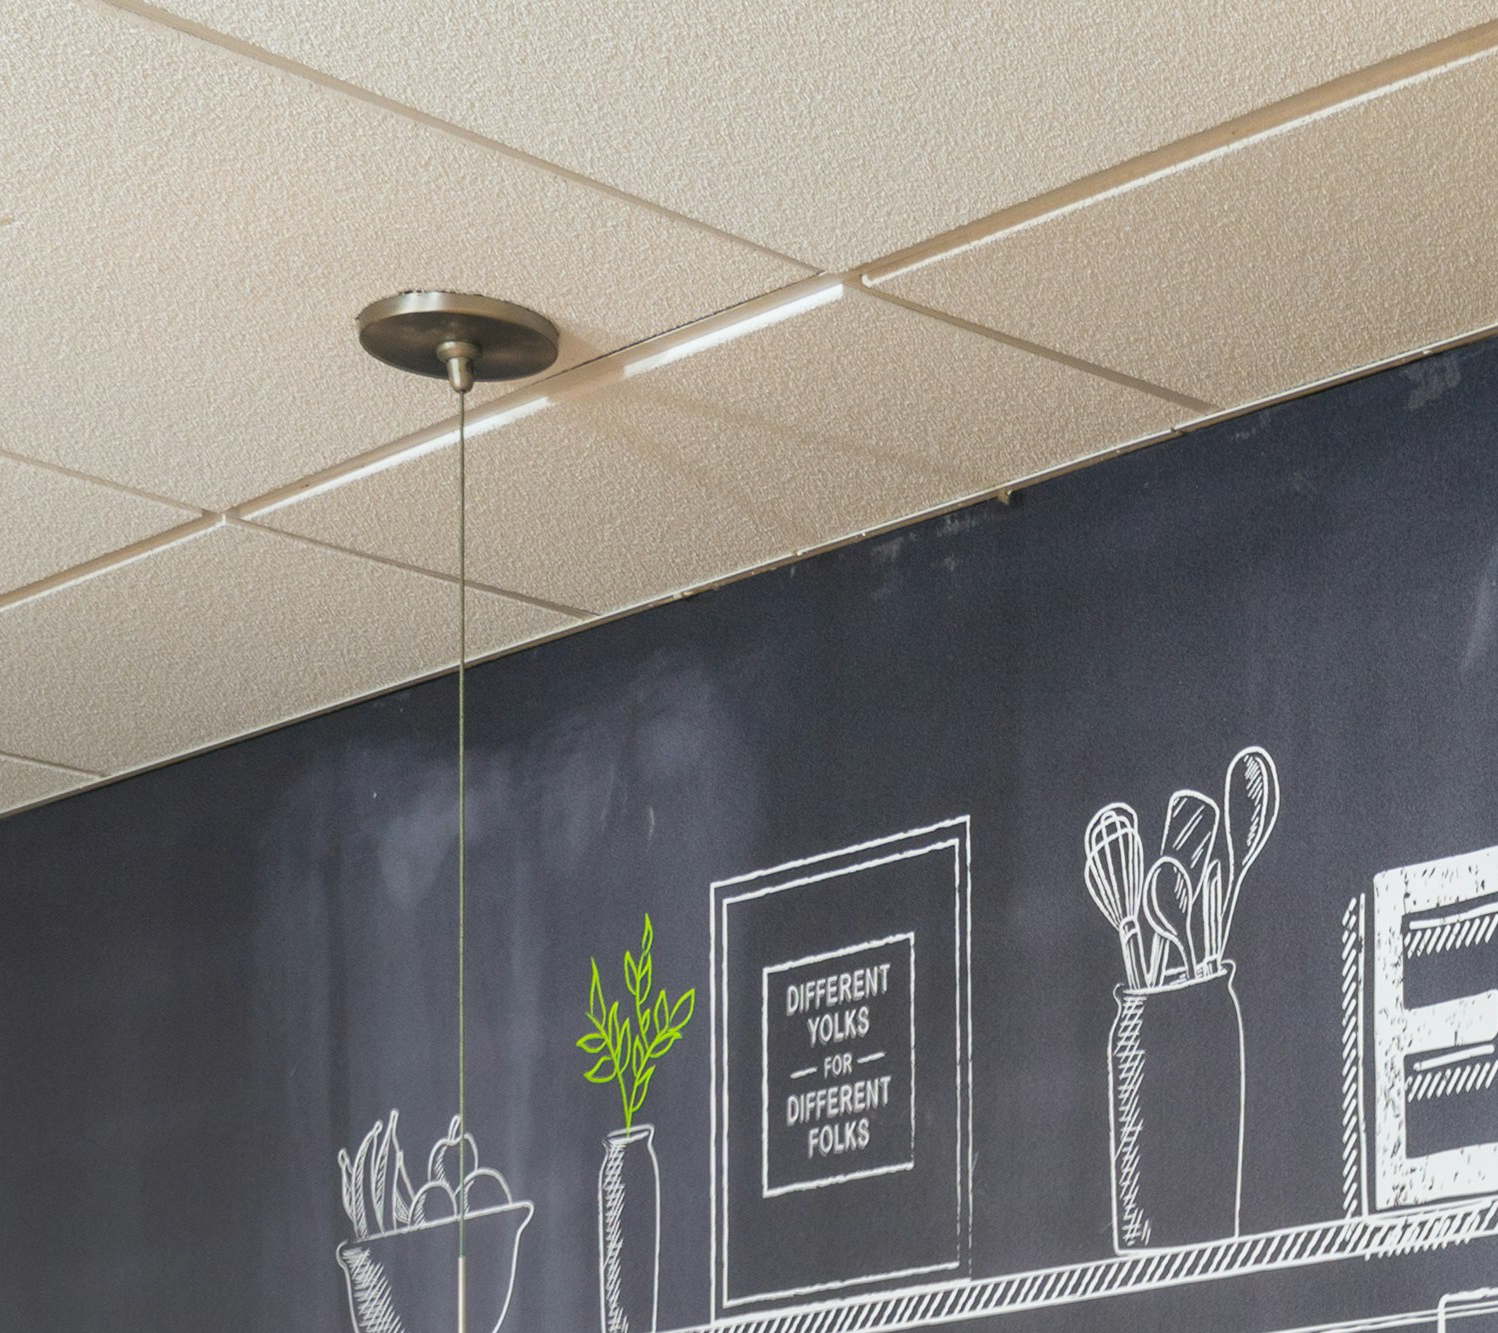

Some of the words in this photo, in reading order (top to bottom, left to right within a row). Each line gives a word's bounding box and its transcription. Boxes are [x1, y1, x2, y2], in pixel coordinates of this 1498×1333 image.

[786, 964, 890, 1016] DIFFERENT
[808, 1007, 870, 1047] YOLKS
[823, 1052, 852, 1079] FOR
[786, 1076, 891, 1127] DIFFERENT
[808, 1119, 870, 1158] FOLKS
